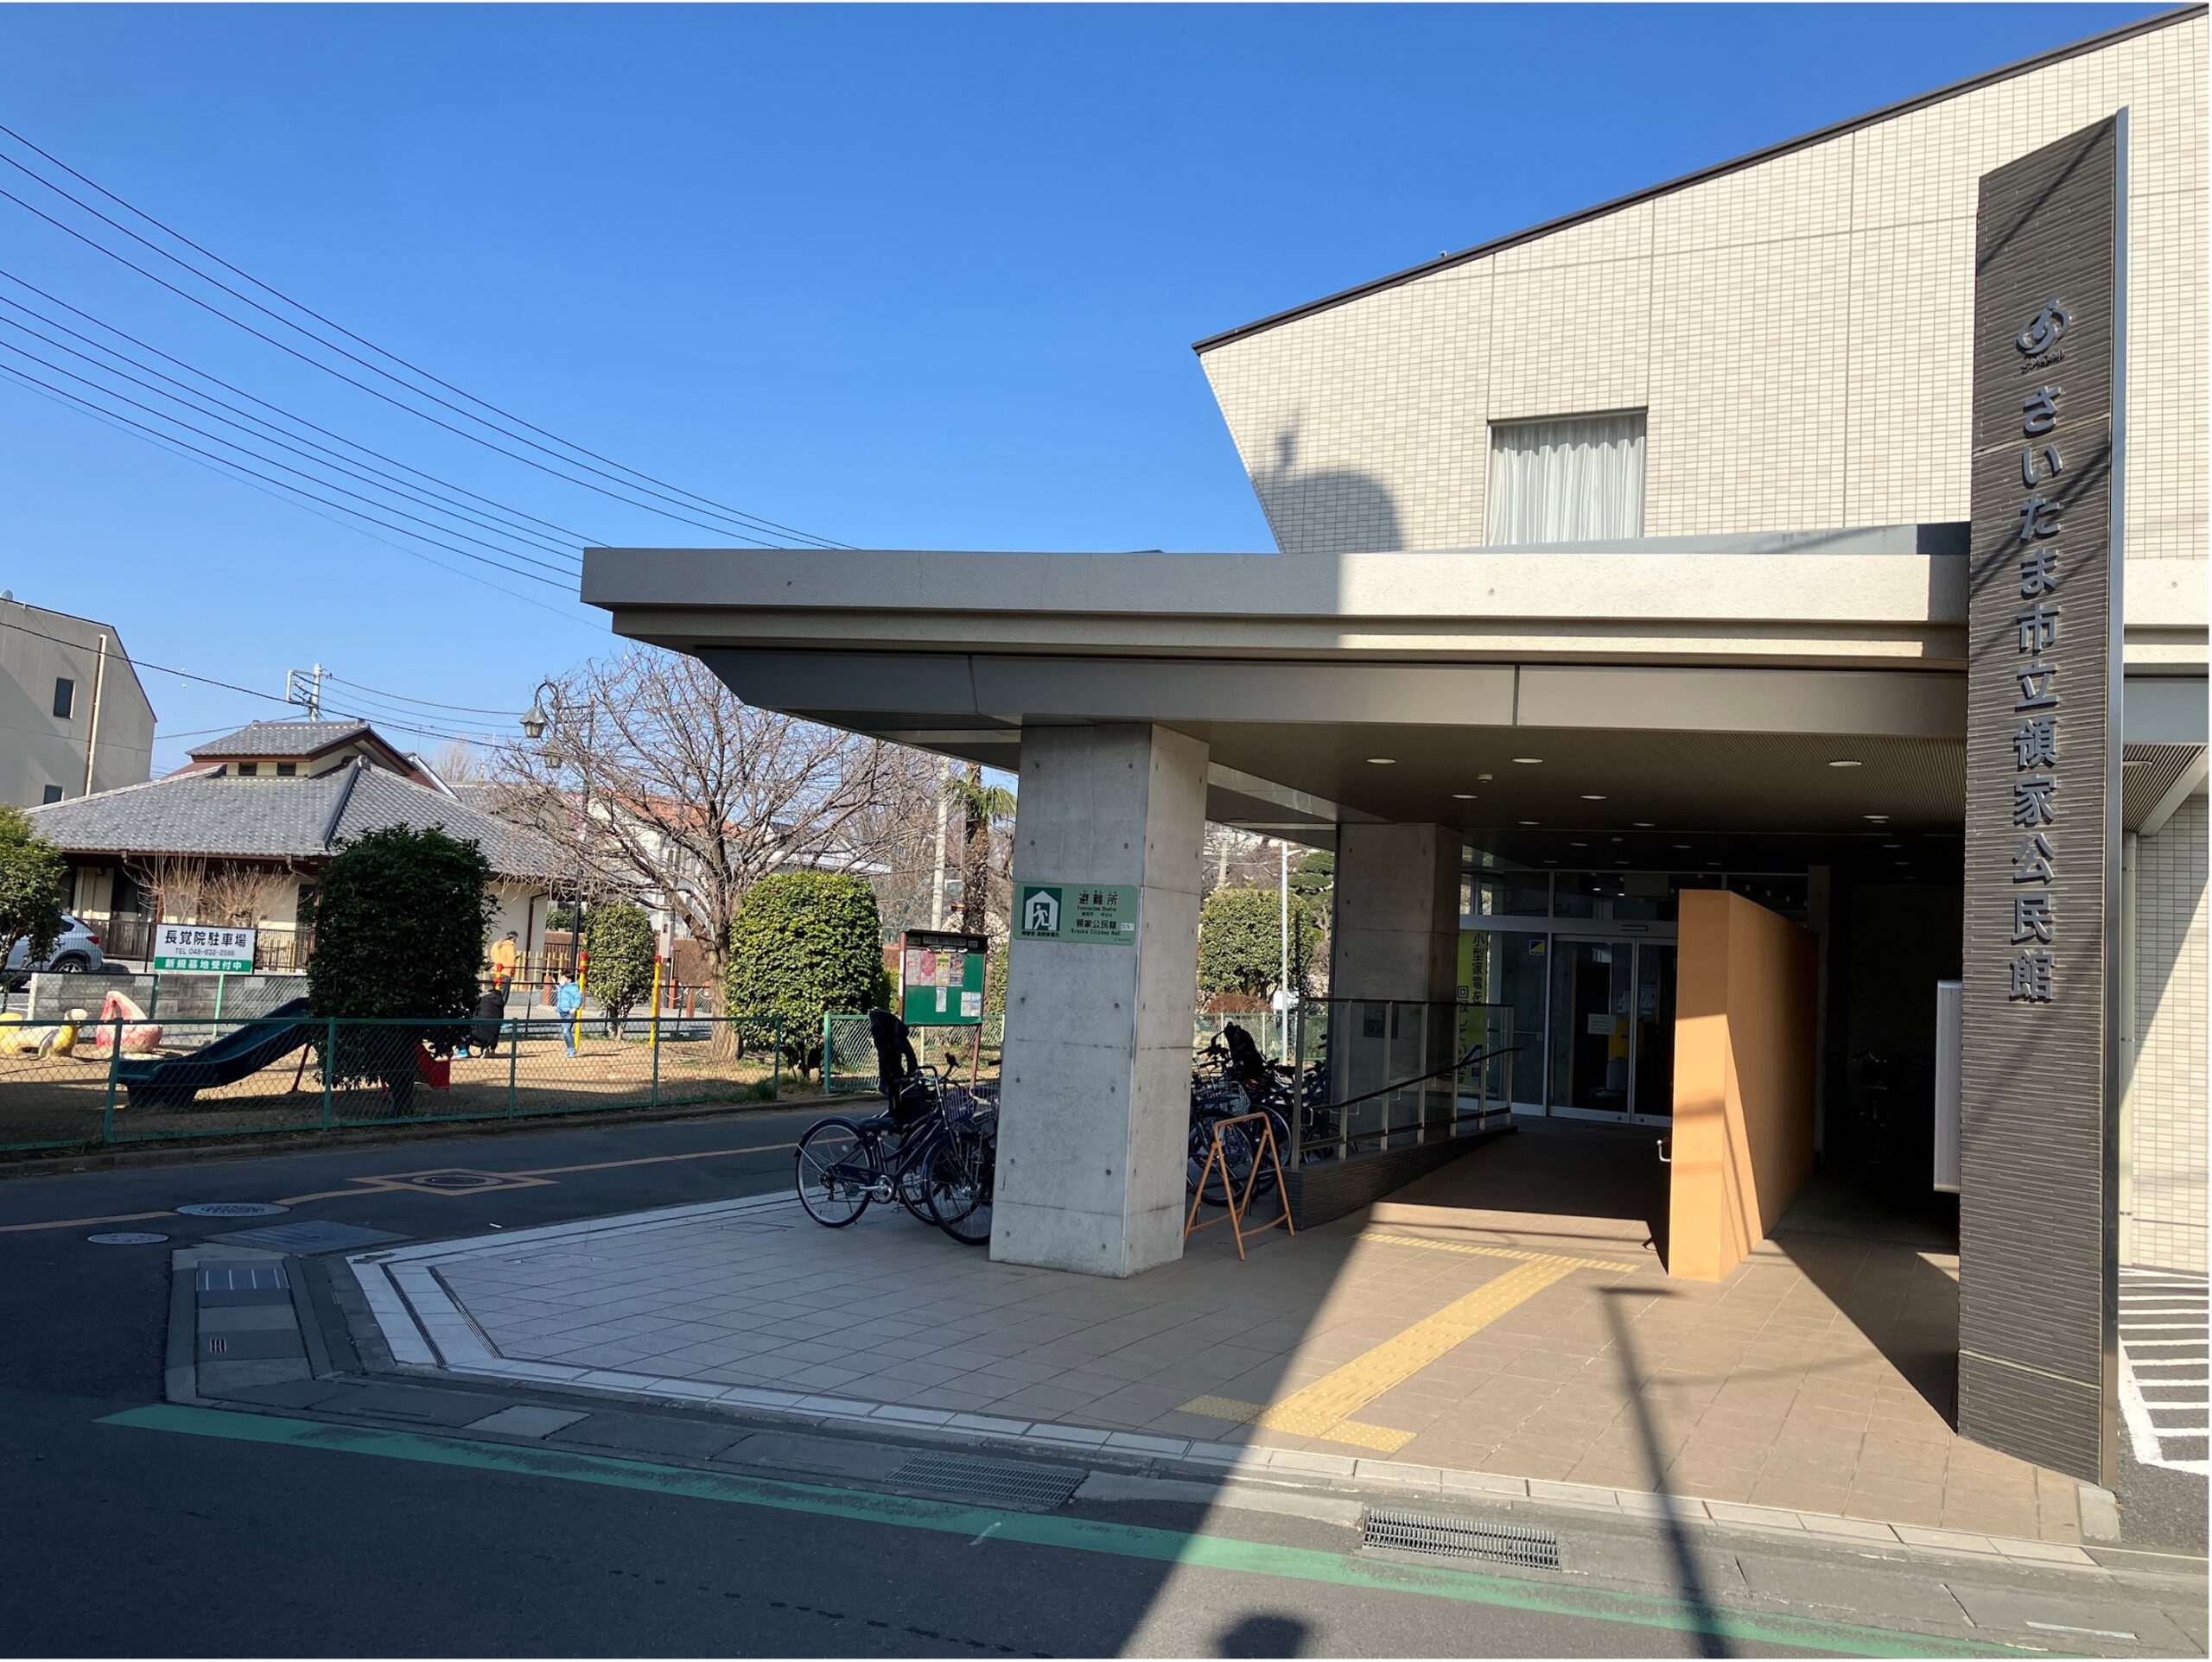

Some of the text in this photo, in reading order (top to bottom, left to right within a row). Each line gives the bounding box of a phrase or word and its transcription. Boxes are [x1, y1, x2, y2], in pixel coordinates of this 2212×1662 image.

[2010, 385, 2063, 1003] さいたま市立領家公民館
[1078, 893, 1118, 906] 避難所
[1076, 918, 1117, 929] 領家公民館
[165, 930, 247, 948] 長覚院駐車場
[164, 959, 242, 971] 新規墓地受付中
